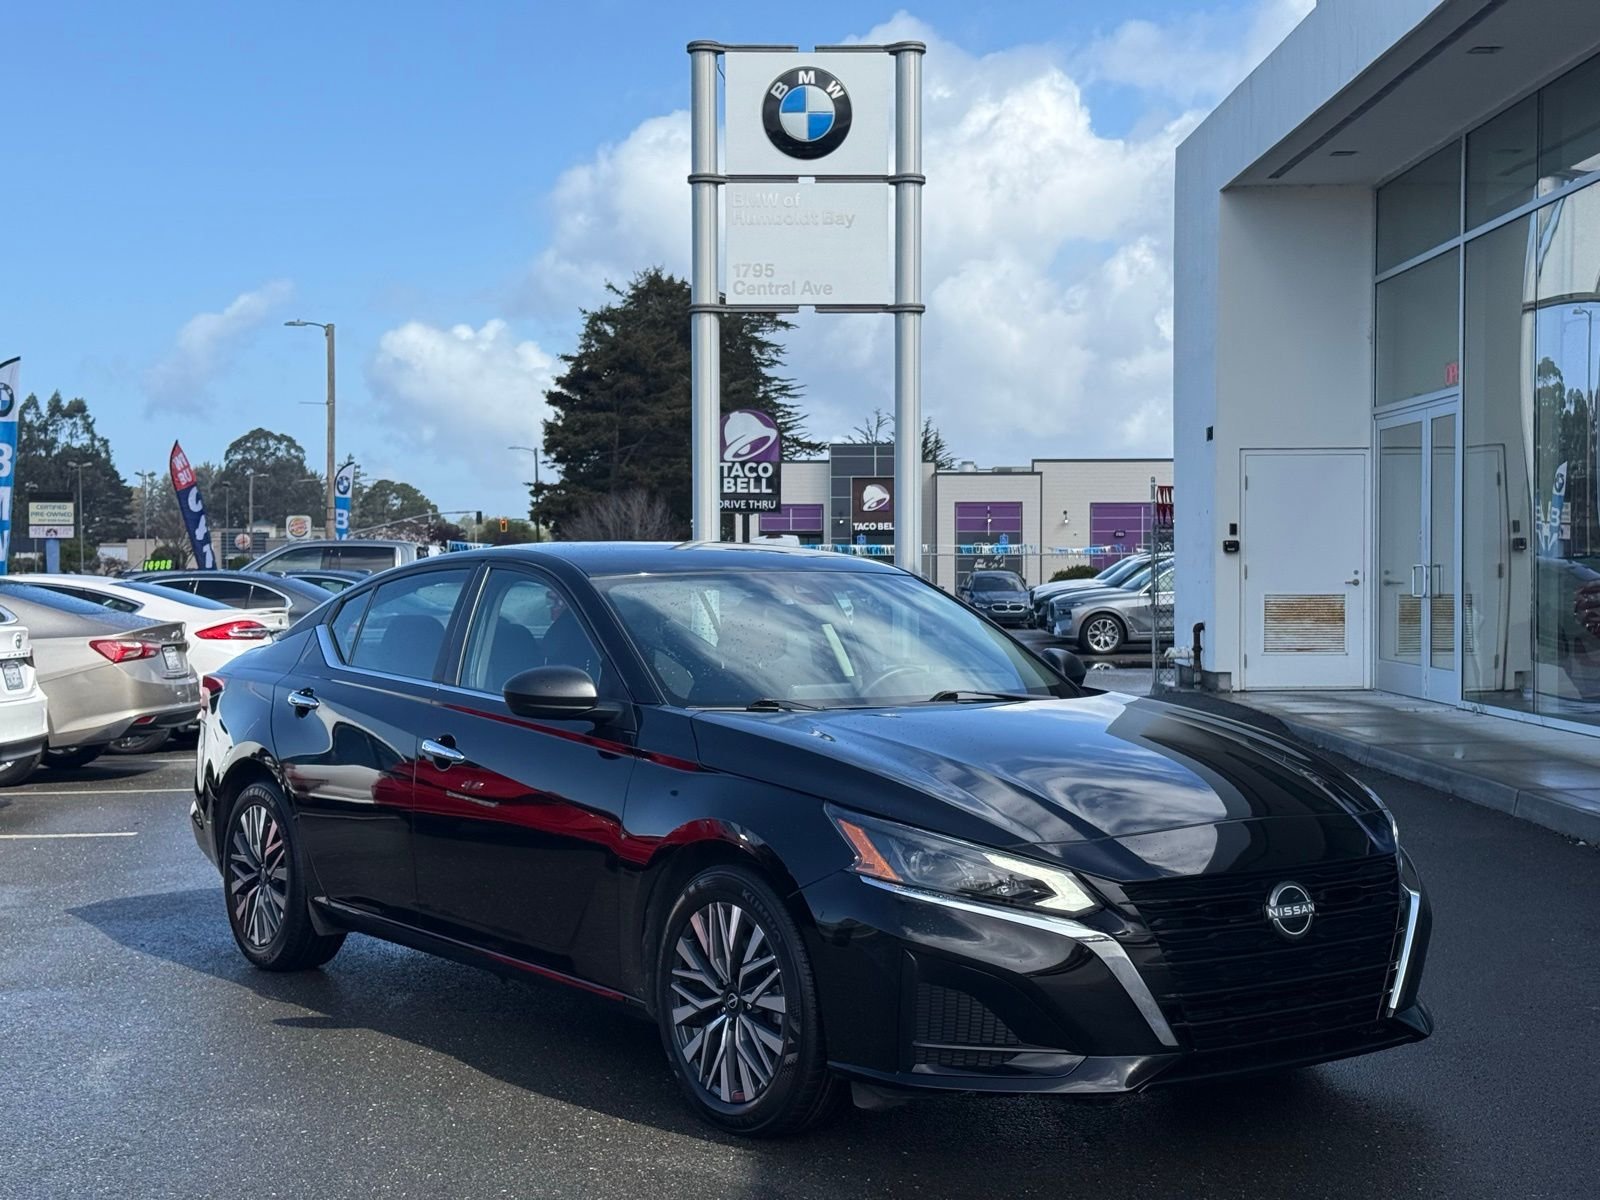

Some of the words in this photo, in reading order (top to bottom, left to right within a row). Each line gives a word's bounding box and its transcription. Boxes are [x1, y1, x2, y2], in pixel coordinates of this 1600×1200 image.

[770, 70, 845, 100] BMW
[732, 192, 781, 208] BMW
[783, 193, 801, 208] of
[822, 210, 857, 229] Bay
[732, 264, 775, 278] 1795
[732, 281, 796, 296] Central
[801, 281, 833, 296] Ave
[720, 462, 773, 478] TACO
[723, 478, 772, 493] BELL
[748, 499, 776, 510] THRU
[852, 522, 877, 531] TACO
[878, 522, 895, 531] BEL
[1268, 902, 1315, 917] NISSAN
